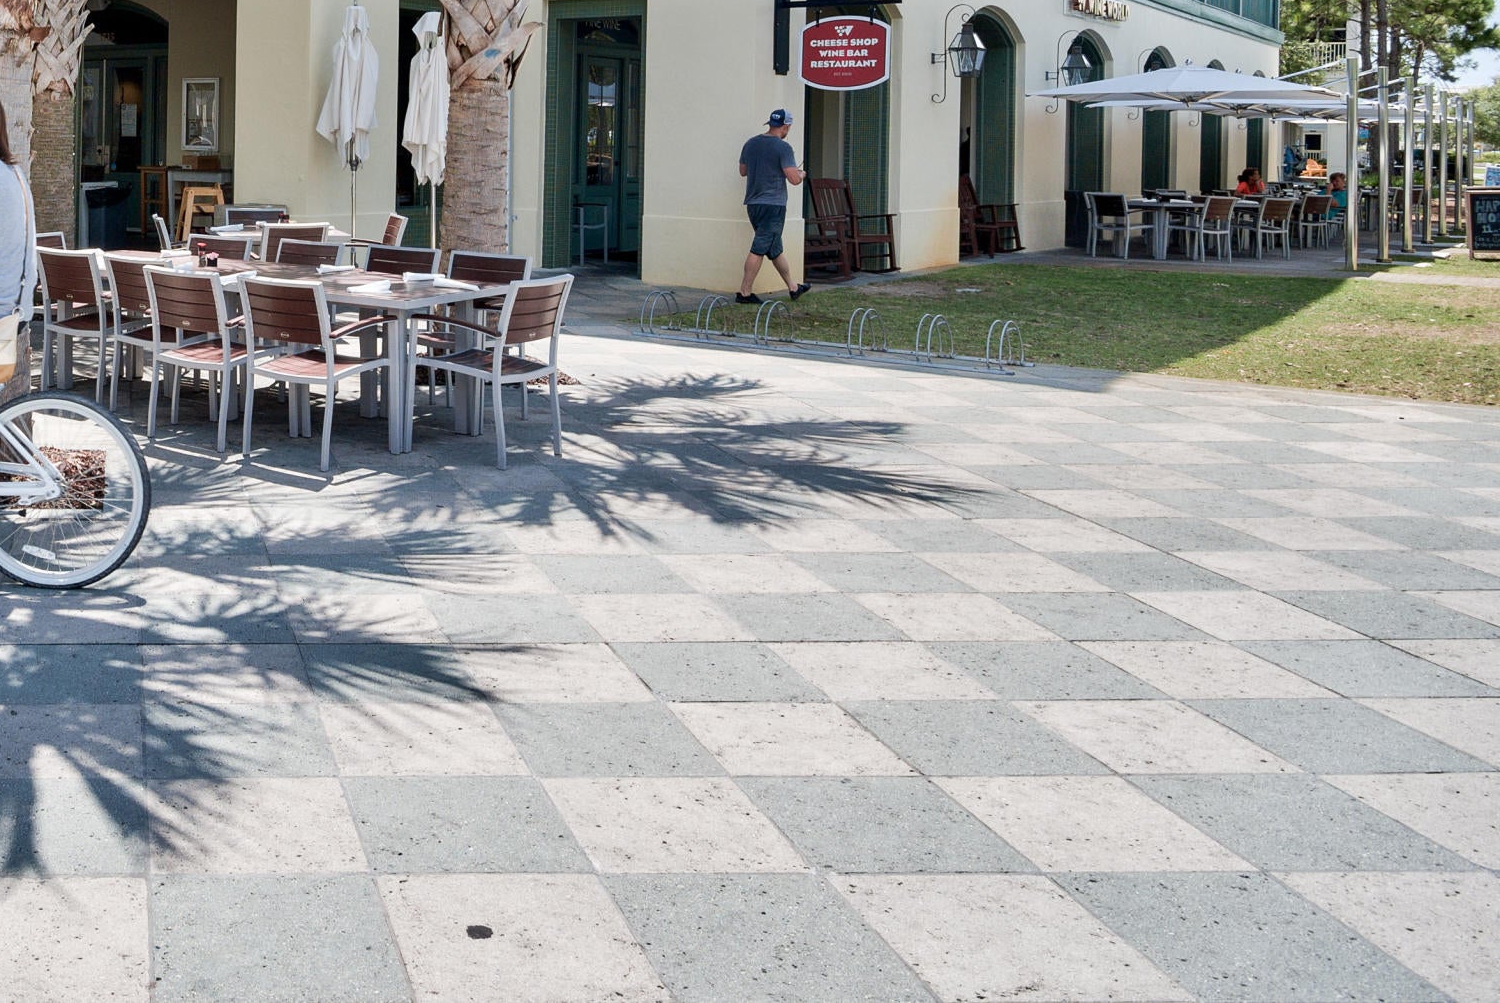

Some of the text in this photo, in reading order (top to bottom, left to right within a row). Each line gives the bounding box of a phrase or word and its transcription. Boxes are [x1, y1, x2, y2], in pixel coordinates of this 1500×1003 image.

[1107, 0, 1130, 20] WORLD
[810, 38, 879, 47] CHEESE SHOP
[819, 49, 869, 57] WINE BAR
[810, 59, 878, 68] RESTAURANT
